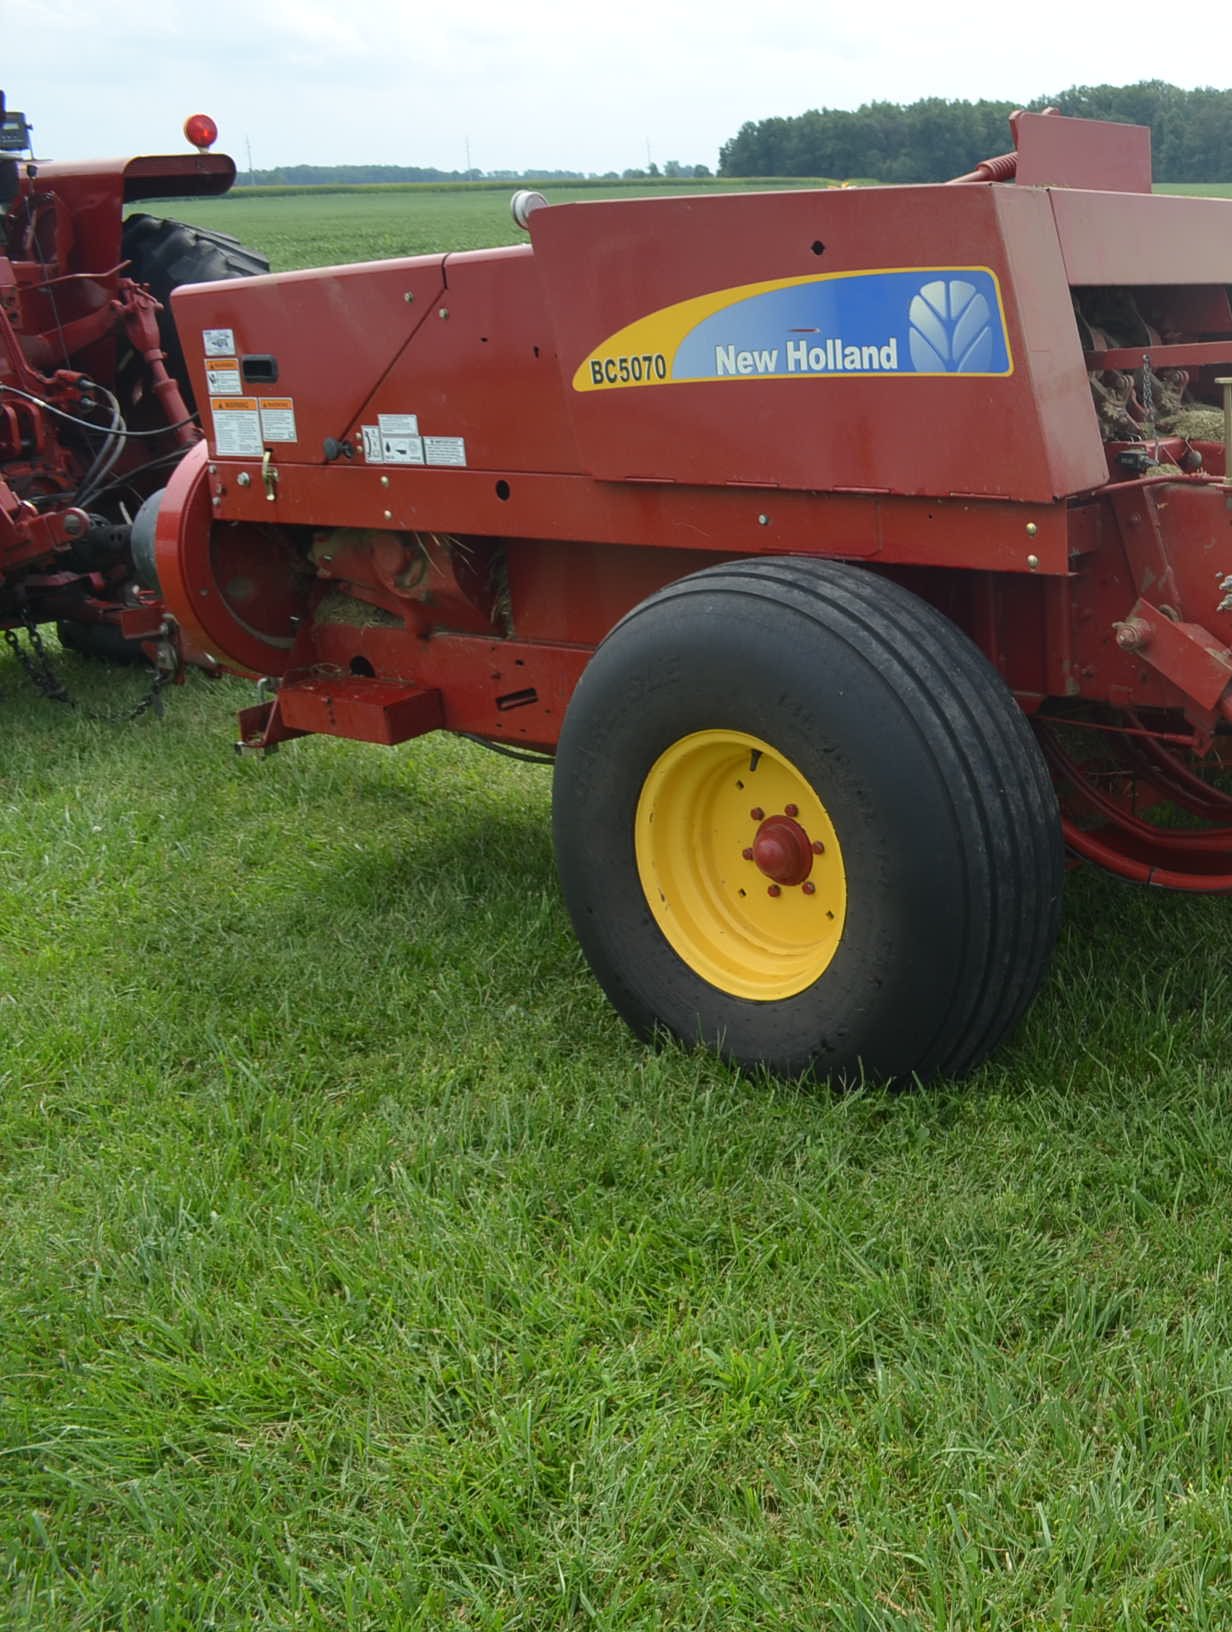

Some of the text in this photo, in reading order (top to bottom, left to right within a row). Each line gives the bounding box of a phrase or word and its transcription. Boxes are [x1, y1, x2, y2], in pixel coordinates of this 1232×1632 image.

[591, 354, 666, 384] BC5070
[716, 337, 898, 375] New Holland
